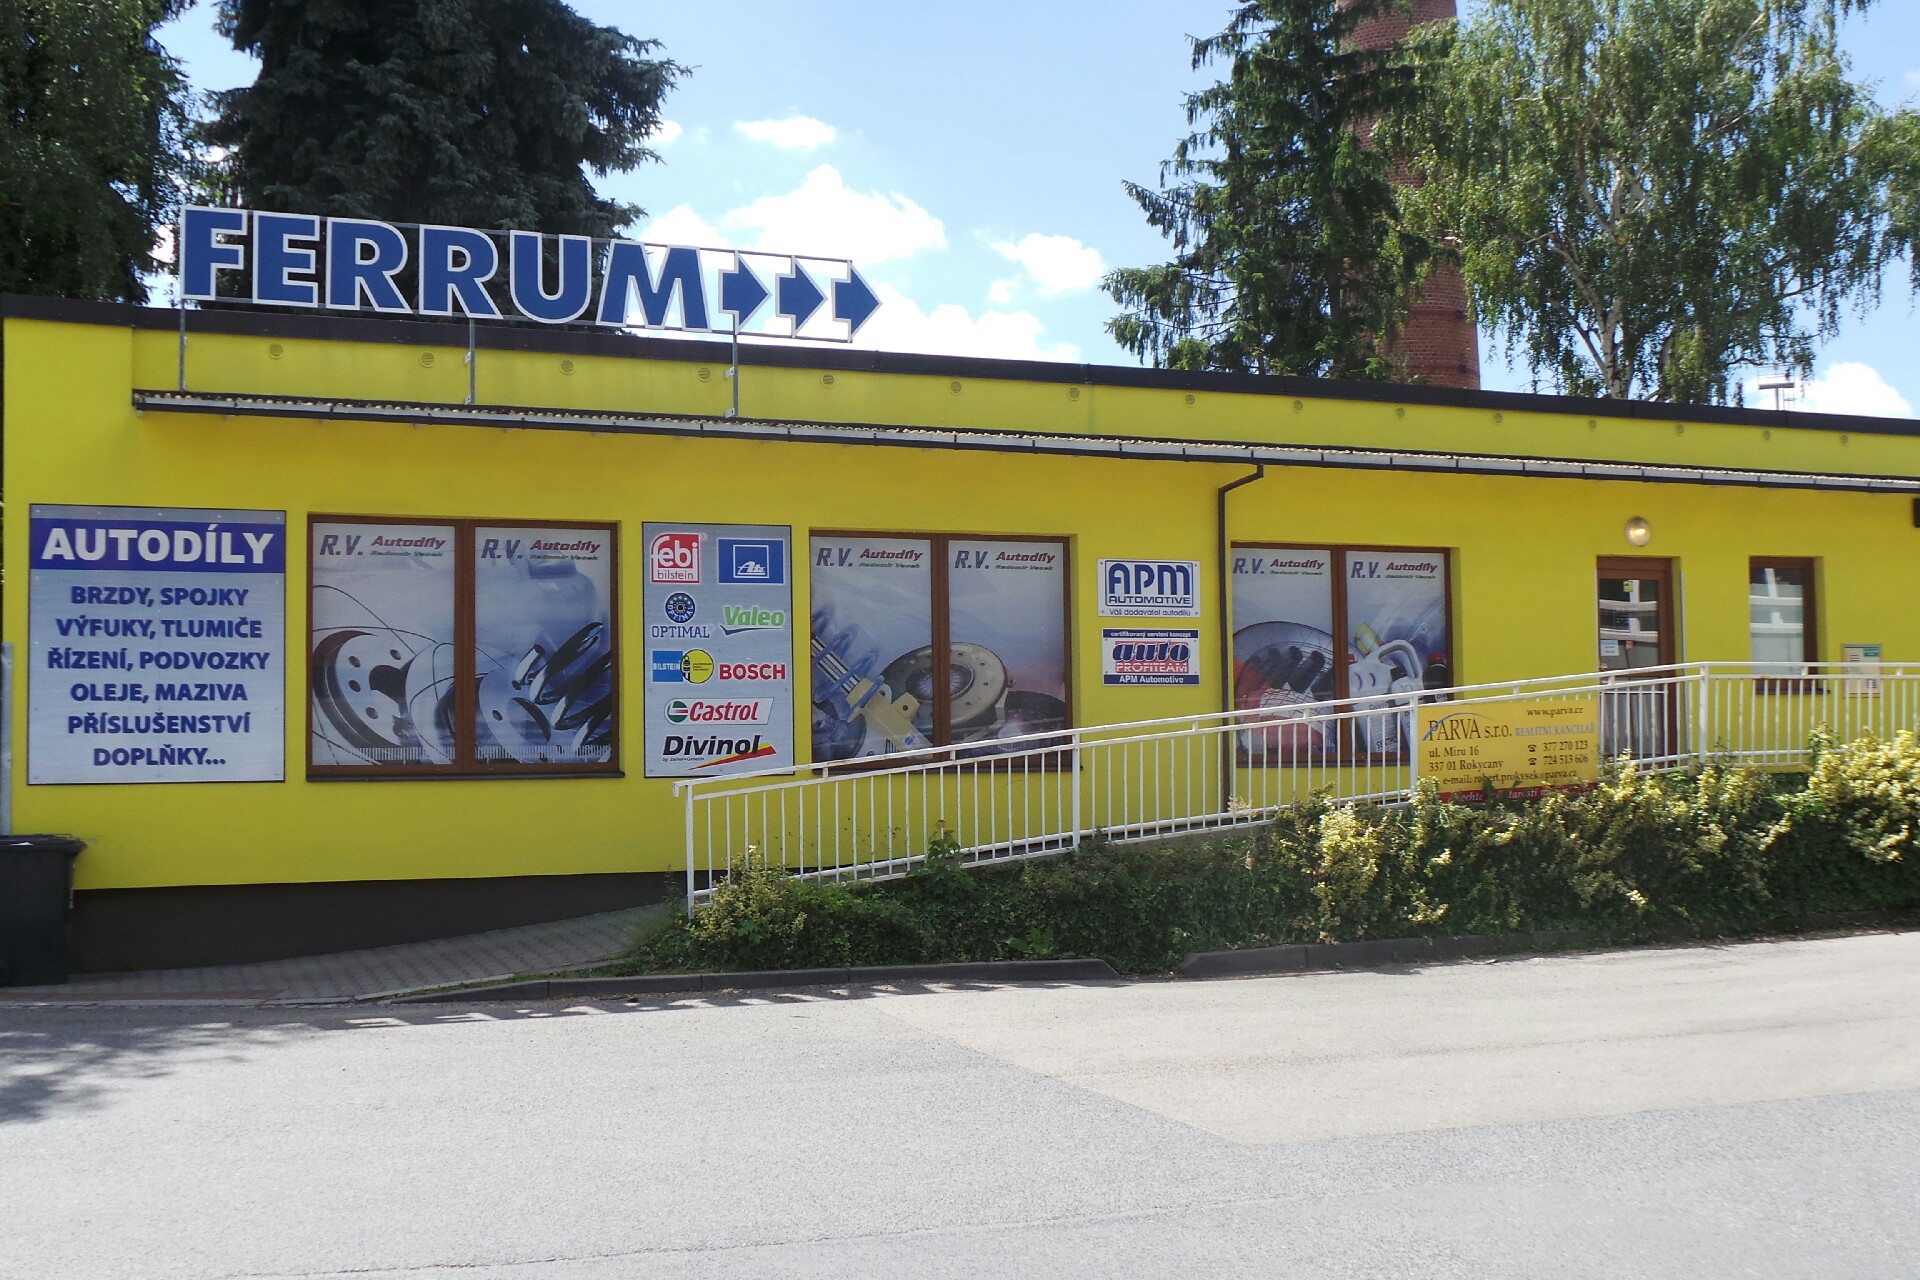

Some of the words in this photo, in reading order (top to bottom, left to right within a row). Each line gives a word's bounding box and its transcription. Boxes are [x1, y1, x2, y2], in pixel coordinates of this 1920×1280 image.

[179, 205, 711, 332] FERRUM
[41, 524, 274, 564] AUTODÍLY
[320, 534, 363, 556] R.V.
[481, 538, 522, 559] R.V.
[651, 536, 698, 568] febi
[816, 547, 853, 567] R.V.
[954, 550, 989, 569] R.V.
[1232, 558, 1264, 574] R.V.
[657, 570, 694, 580] bilstein
[1109, 563, 1190, 595] APM
[1351, 561, 1380, 578] R.V.
[71, 586, 153, 608] BRZDY,
[160, 588, 249, 606] SPOJKY
[1109, 596, 1190, 604] AUTOMOTIVE
[724, 606, 785, 626] Valeo
[56, 615, 156, 639] VÝFUKY,
[161, 617, 262, 638] TLUMIČE
[651, 626, 710, 638] OPTIMAL
[47, 647, 134, 672] ŘÍZENÍ,
[139, 651, 270, 670] PODVOZKY
[1112, 642, 1190, 662] auto
[719, 664, 786, 680] BOSCH
[1116, 663, 1187, 672] PROFITEAM
[70, 683, 149, 704] OLEJE,
[155, 683, 248, 701] MAZIVA
[690, 702, 759, 721] Castrol
[1527, 708, 1583, 718] www.parva.cz
[68, 711, 251, 734] PŘÍSLUŠENSTVÍ
[1428, 718, 1481, 741] PARVA
[1484, 724, 1512, 738] s.r.o.
[93, 744, 226, 766] DOPLŇKY...
[663, 735, 760, 755] Divinol
[1429, 748, 1440, 757] ul.
[1469, 746, 1479, 755] 16
[1543, 742, 1557, 751] 377
[1559, 741, 1572, 750] 270
[1575, 740, 1588, 749] 123
[1429, 762, 1444, 771] 337
[1447, 761, 1457, 770] 01
[1460, 760, 1503, 772] Rokycany
[1543, 755, 1557, 764] 724
[1560, 755, 1573, 764] 513
[1443, 775, 1472, 784] e-mail:
